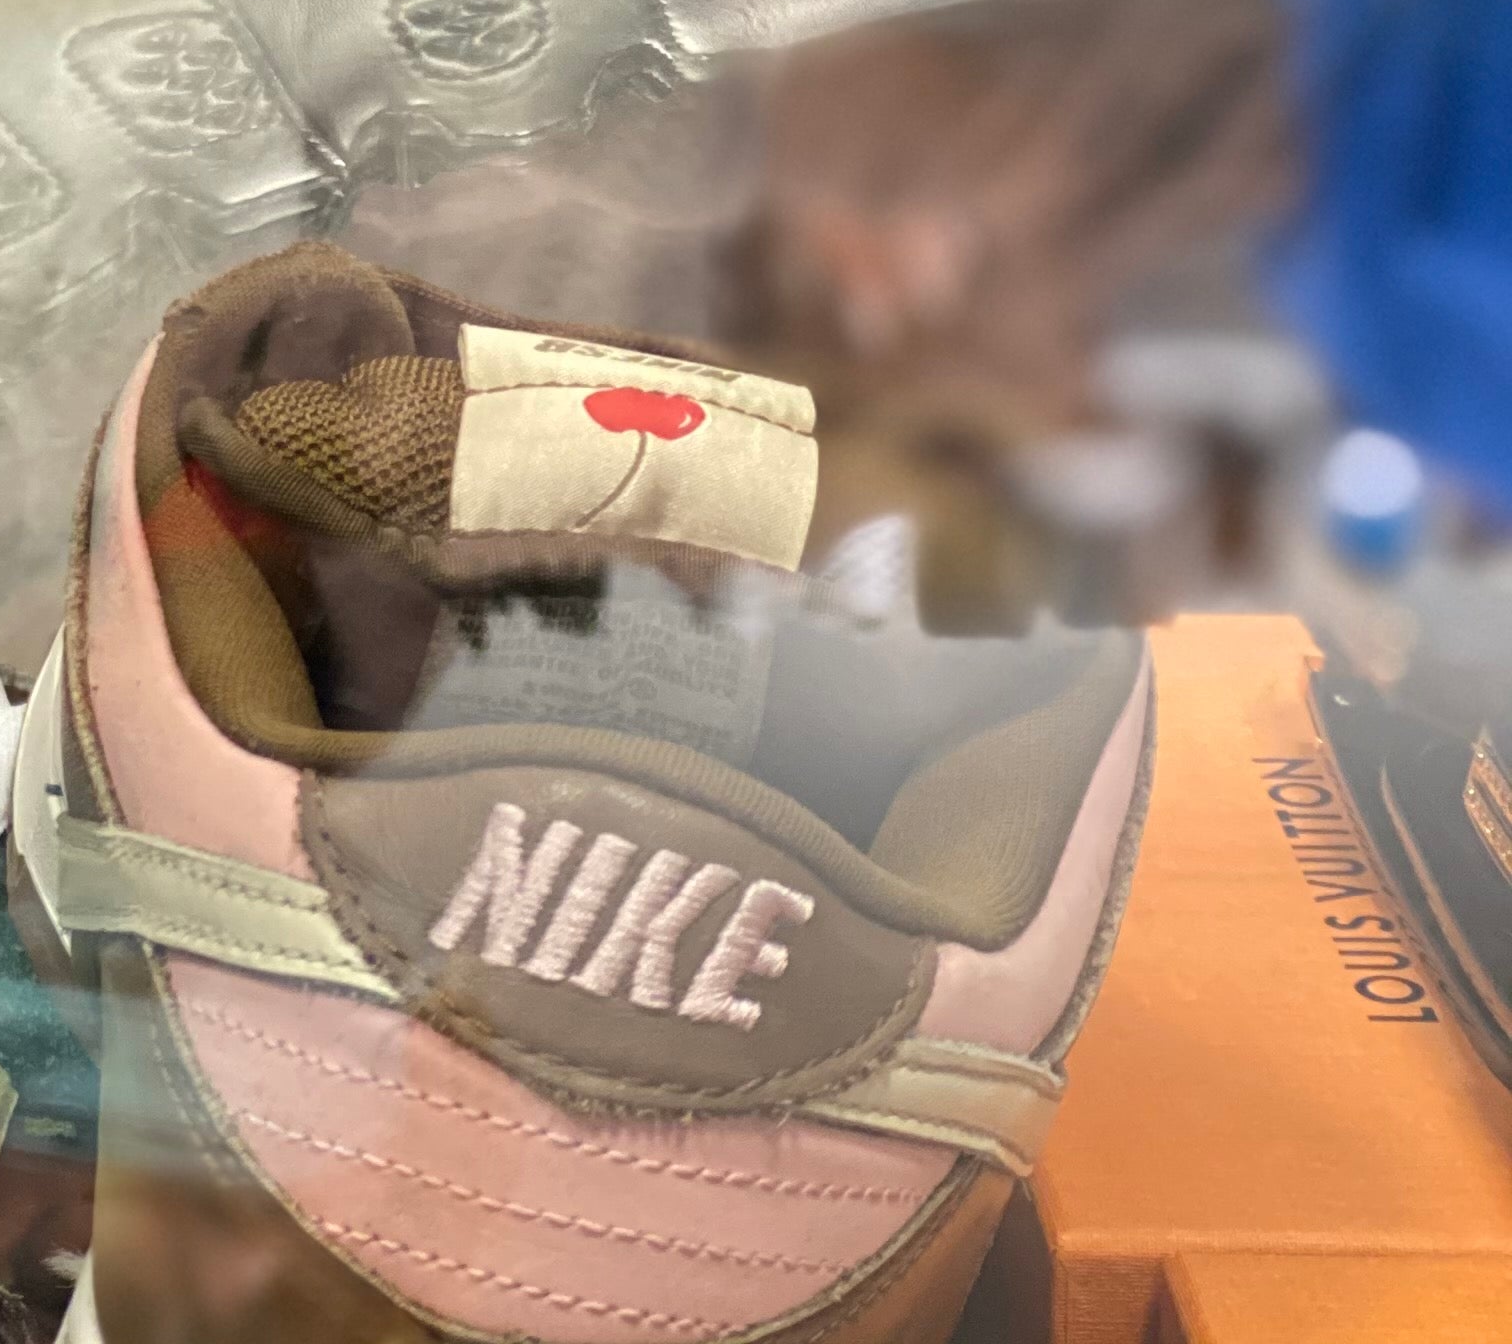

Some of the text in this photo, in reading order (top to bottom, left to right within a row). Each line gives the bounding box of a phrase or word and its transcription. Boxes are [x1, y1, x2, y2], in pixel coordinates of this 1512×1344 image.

[429, 802, 815, 1032] NIKE
[1251, 757, 1440, 1023] LOUIS VUITTON
